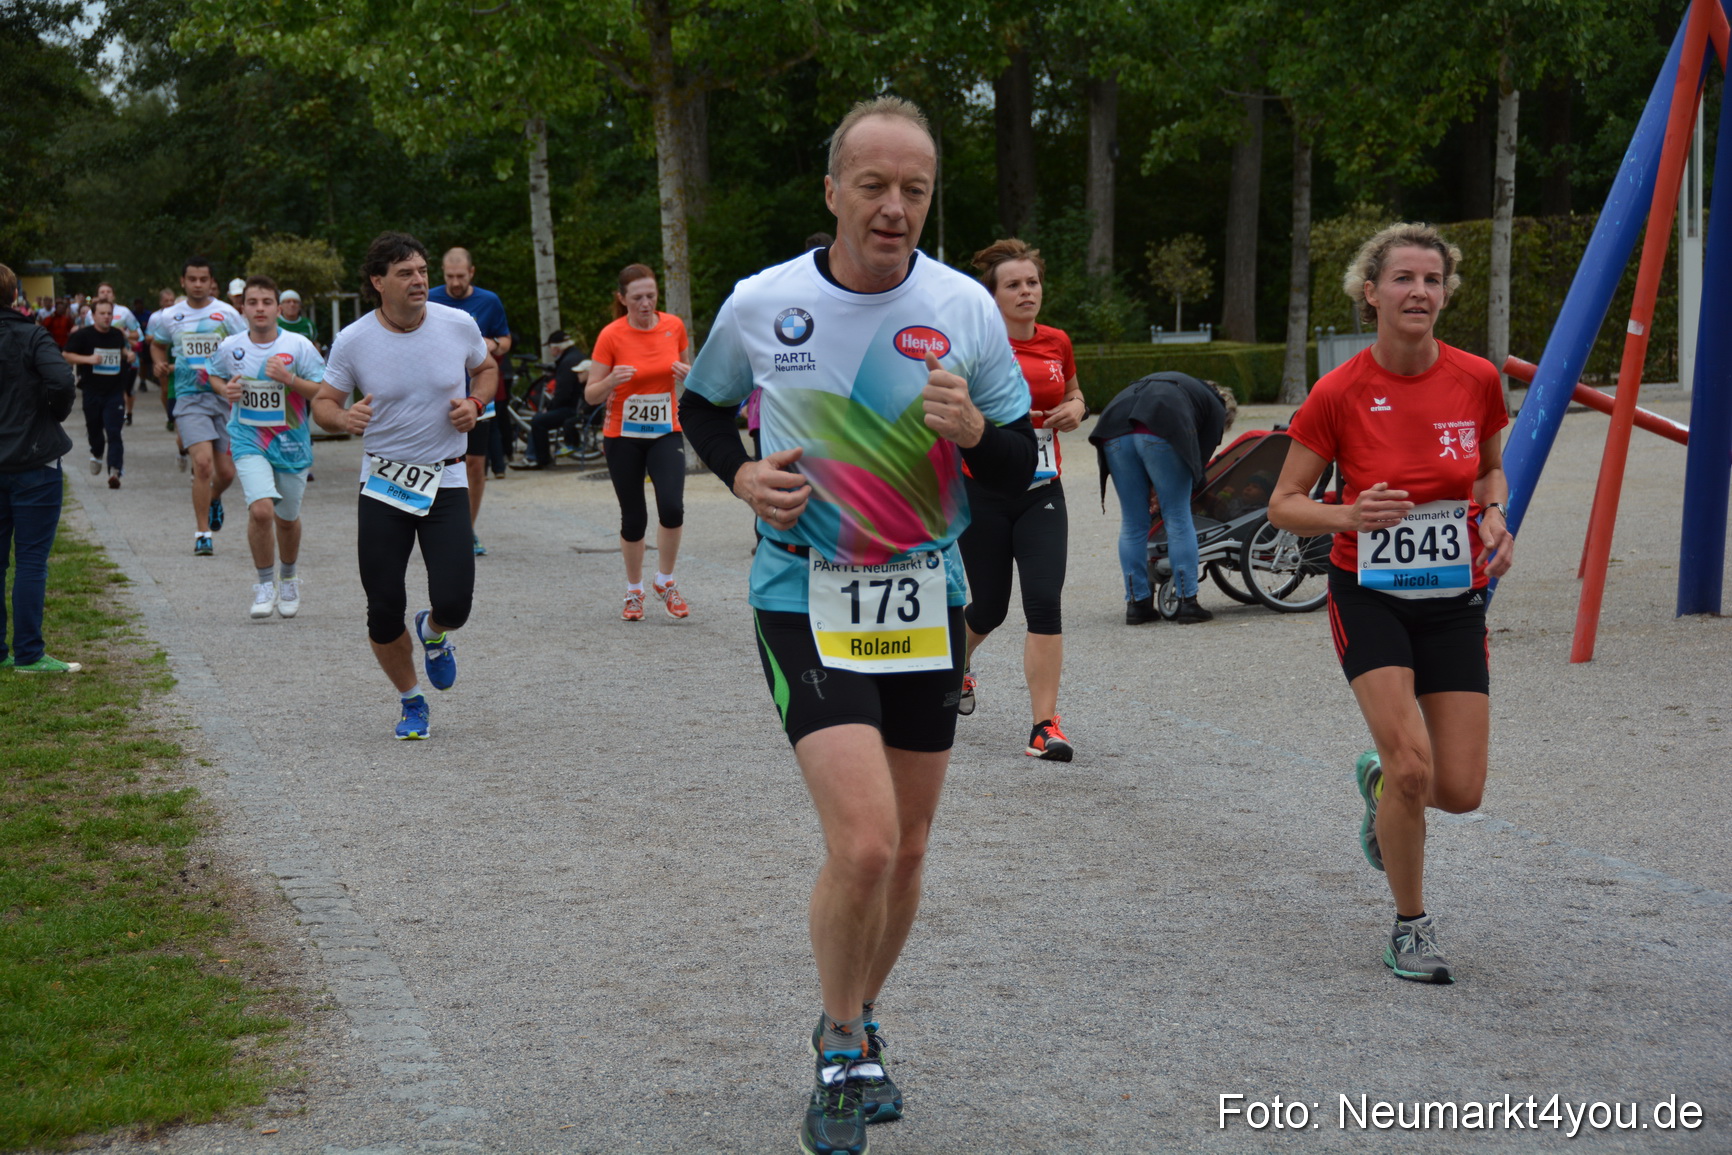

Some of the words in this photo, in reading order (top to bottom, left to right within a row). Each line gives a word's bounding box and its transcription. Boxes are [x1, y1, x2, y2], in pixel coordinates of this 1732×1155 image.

[186, 341, 219, 356] 3084
[901, 333, 944, 352] Hervis
[774, 352, 816, 364] PARTL
[775, 363, 817, 372] Neumarkt
[242, 389, 281, 409] 3089
[628, 404, 667, 422] 2491
[1447, 420, 1475, 428] Wolfstein
[377, 458, 435, 492] 2797
[387, 485, 410, 502] Peter
[1370, 523, 1461, 564] 2643
[863, 559, 922, 574] Neumarkt
[1393, 572, 1439, 588] Nicola
[840, 577, 921, 624] 173
[850, 636, 911, 656] Roland
